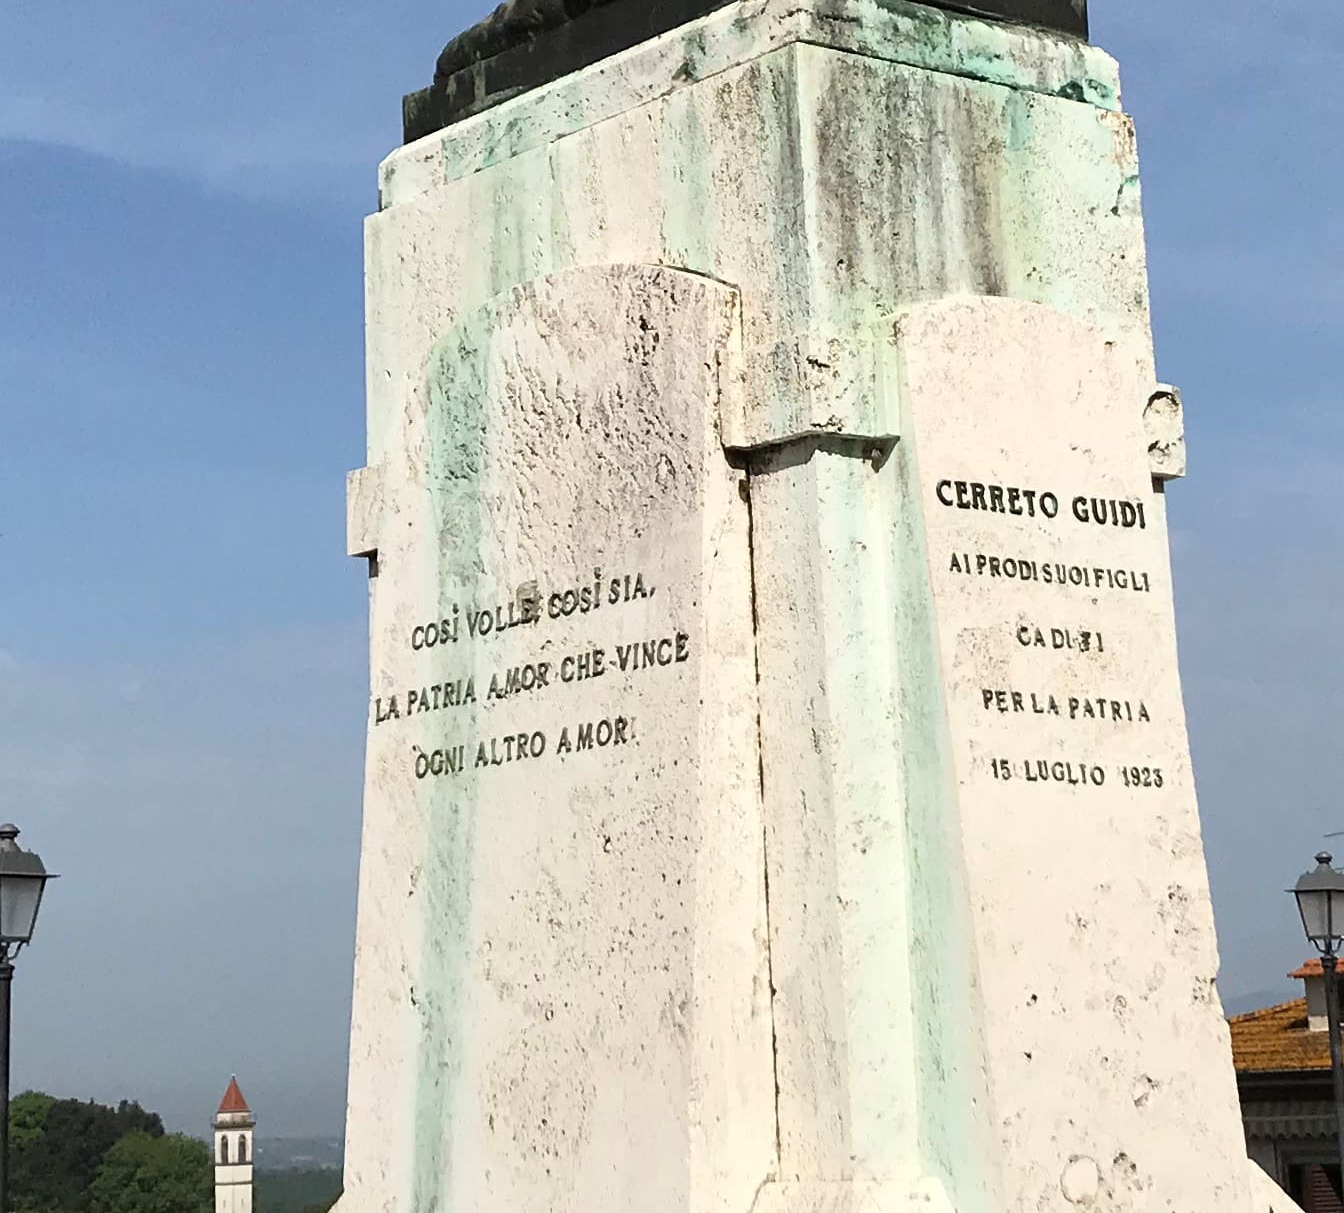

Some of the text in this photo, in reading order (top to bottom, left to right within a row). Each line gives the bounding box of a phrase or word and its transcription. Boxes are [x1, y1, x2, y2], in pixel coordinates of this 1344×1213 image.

[936, 479, 1146, 529] CERRETO GUIDI
[949, 552, 1151, 593] AI PRODI SUOI FIGLI
[375, 694, 400, 726] LA
[406, 674, 478, 717] PATRIA
[487, 661, 552, 701] AMOR
[615, 631, 690, 672] VINCE
[981, 688, 1151, 723] PER LA PATRIA
[414, 744, 465, 780] OGNI
[474, 730, 547, 769] ALTRO
[990, 757, 1164, 788] 15 LUGLIO 1923
